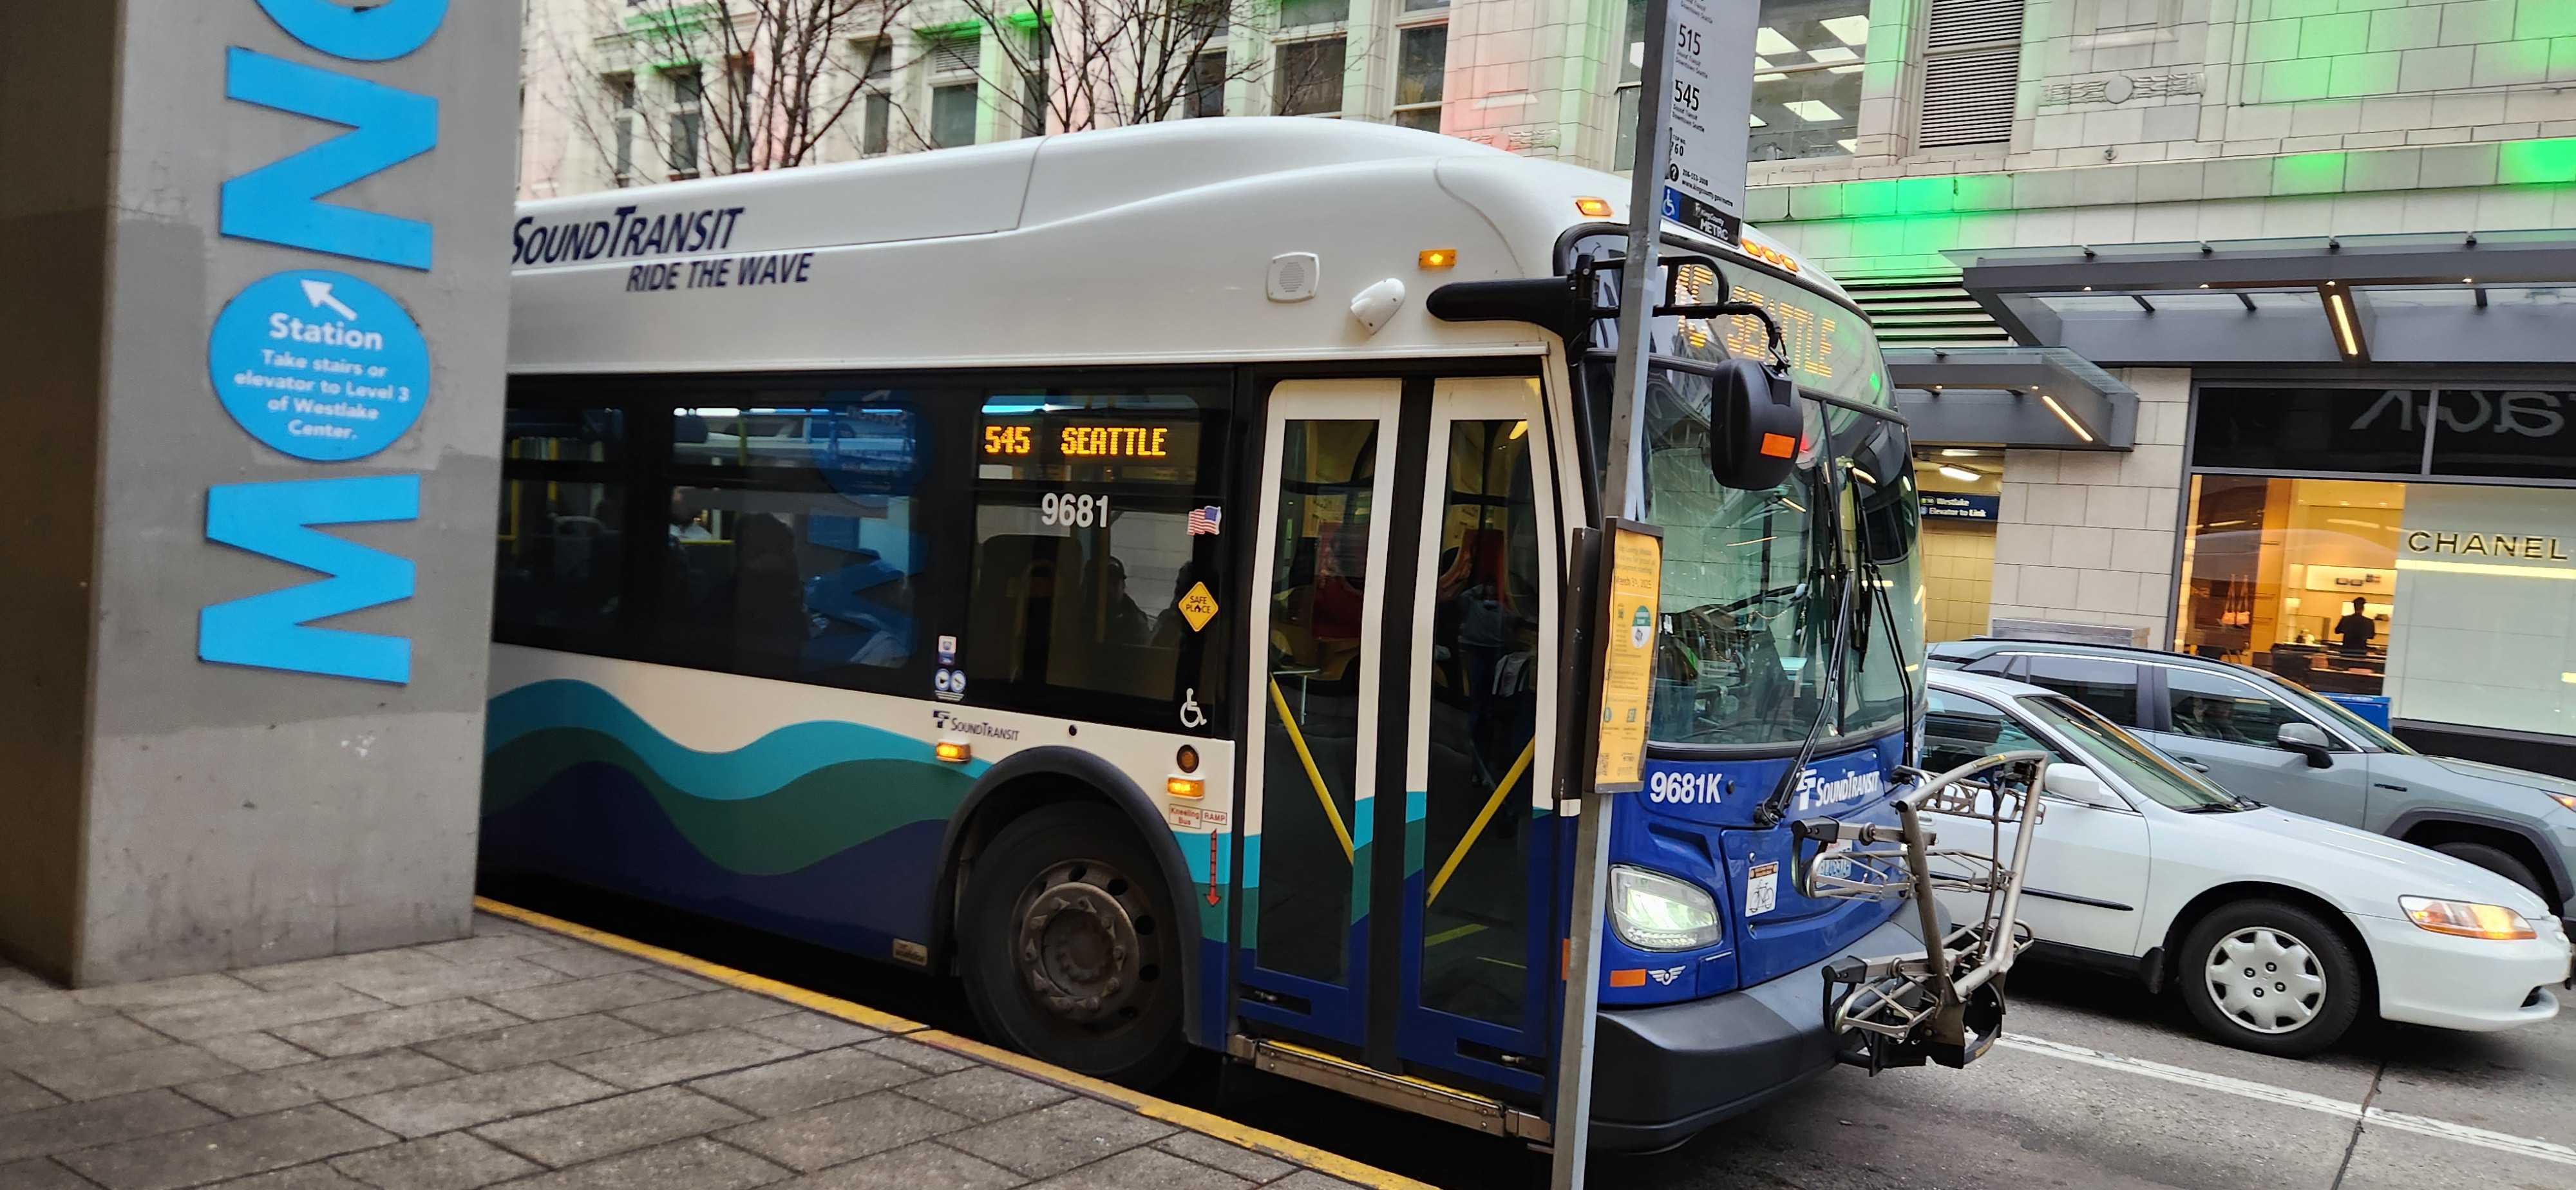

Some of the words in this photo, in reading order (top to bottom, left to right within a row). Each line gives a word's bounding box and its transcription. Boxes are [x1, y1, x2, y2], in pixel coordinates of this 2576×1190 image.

[1678, 23, 1701, 55] 515
[1674, 79, 1700, 111] 545
[625, 261, 684, 292] RIDE
[687, 258, 731, 288] THE
[736, 252, 815, 287] WAVE
[269, 312, 383, 350] Station
[261, 349, 307, 369] Take
[312, 357, 363, 376] stairs
[366, 365, 388, 378] or
[234, 370, 316, 392] elevator
[321, 380, 341, 394] to
[346, 381, 393, 400] Level
[397, 386, 410, 402] 3
[267, 395, 289, 412] of
[293, 398, 379, 420] Westlake
[288, 419, 358, 440] Center.
[985, 426, 1031, 454] 545
[1061, 427, 1168, 456] SEATTLE
[1041, 493, 1108, 528] 9681
[1969, 509, 1987, 517] Link
[2408, 531, 2568, 560] CHANEL
[1189, 595, 1208, 605] SAFE
[1650, 771, 1723, 804] 9681K
[1170, 808, 1199, 820] Kneeling
[1179, 816, 1191, 826] Bus
[1204, 811, 1226, 822] RAMP
